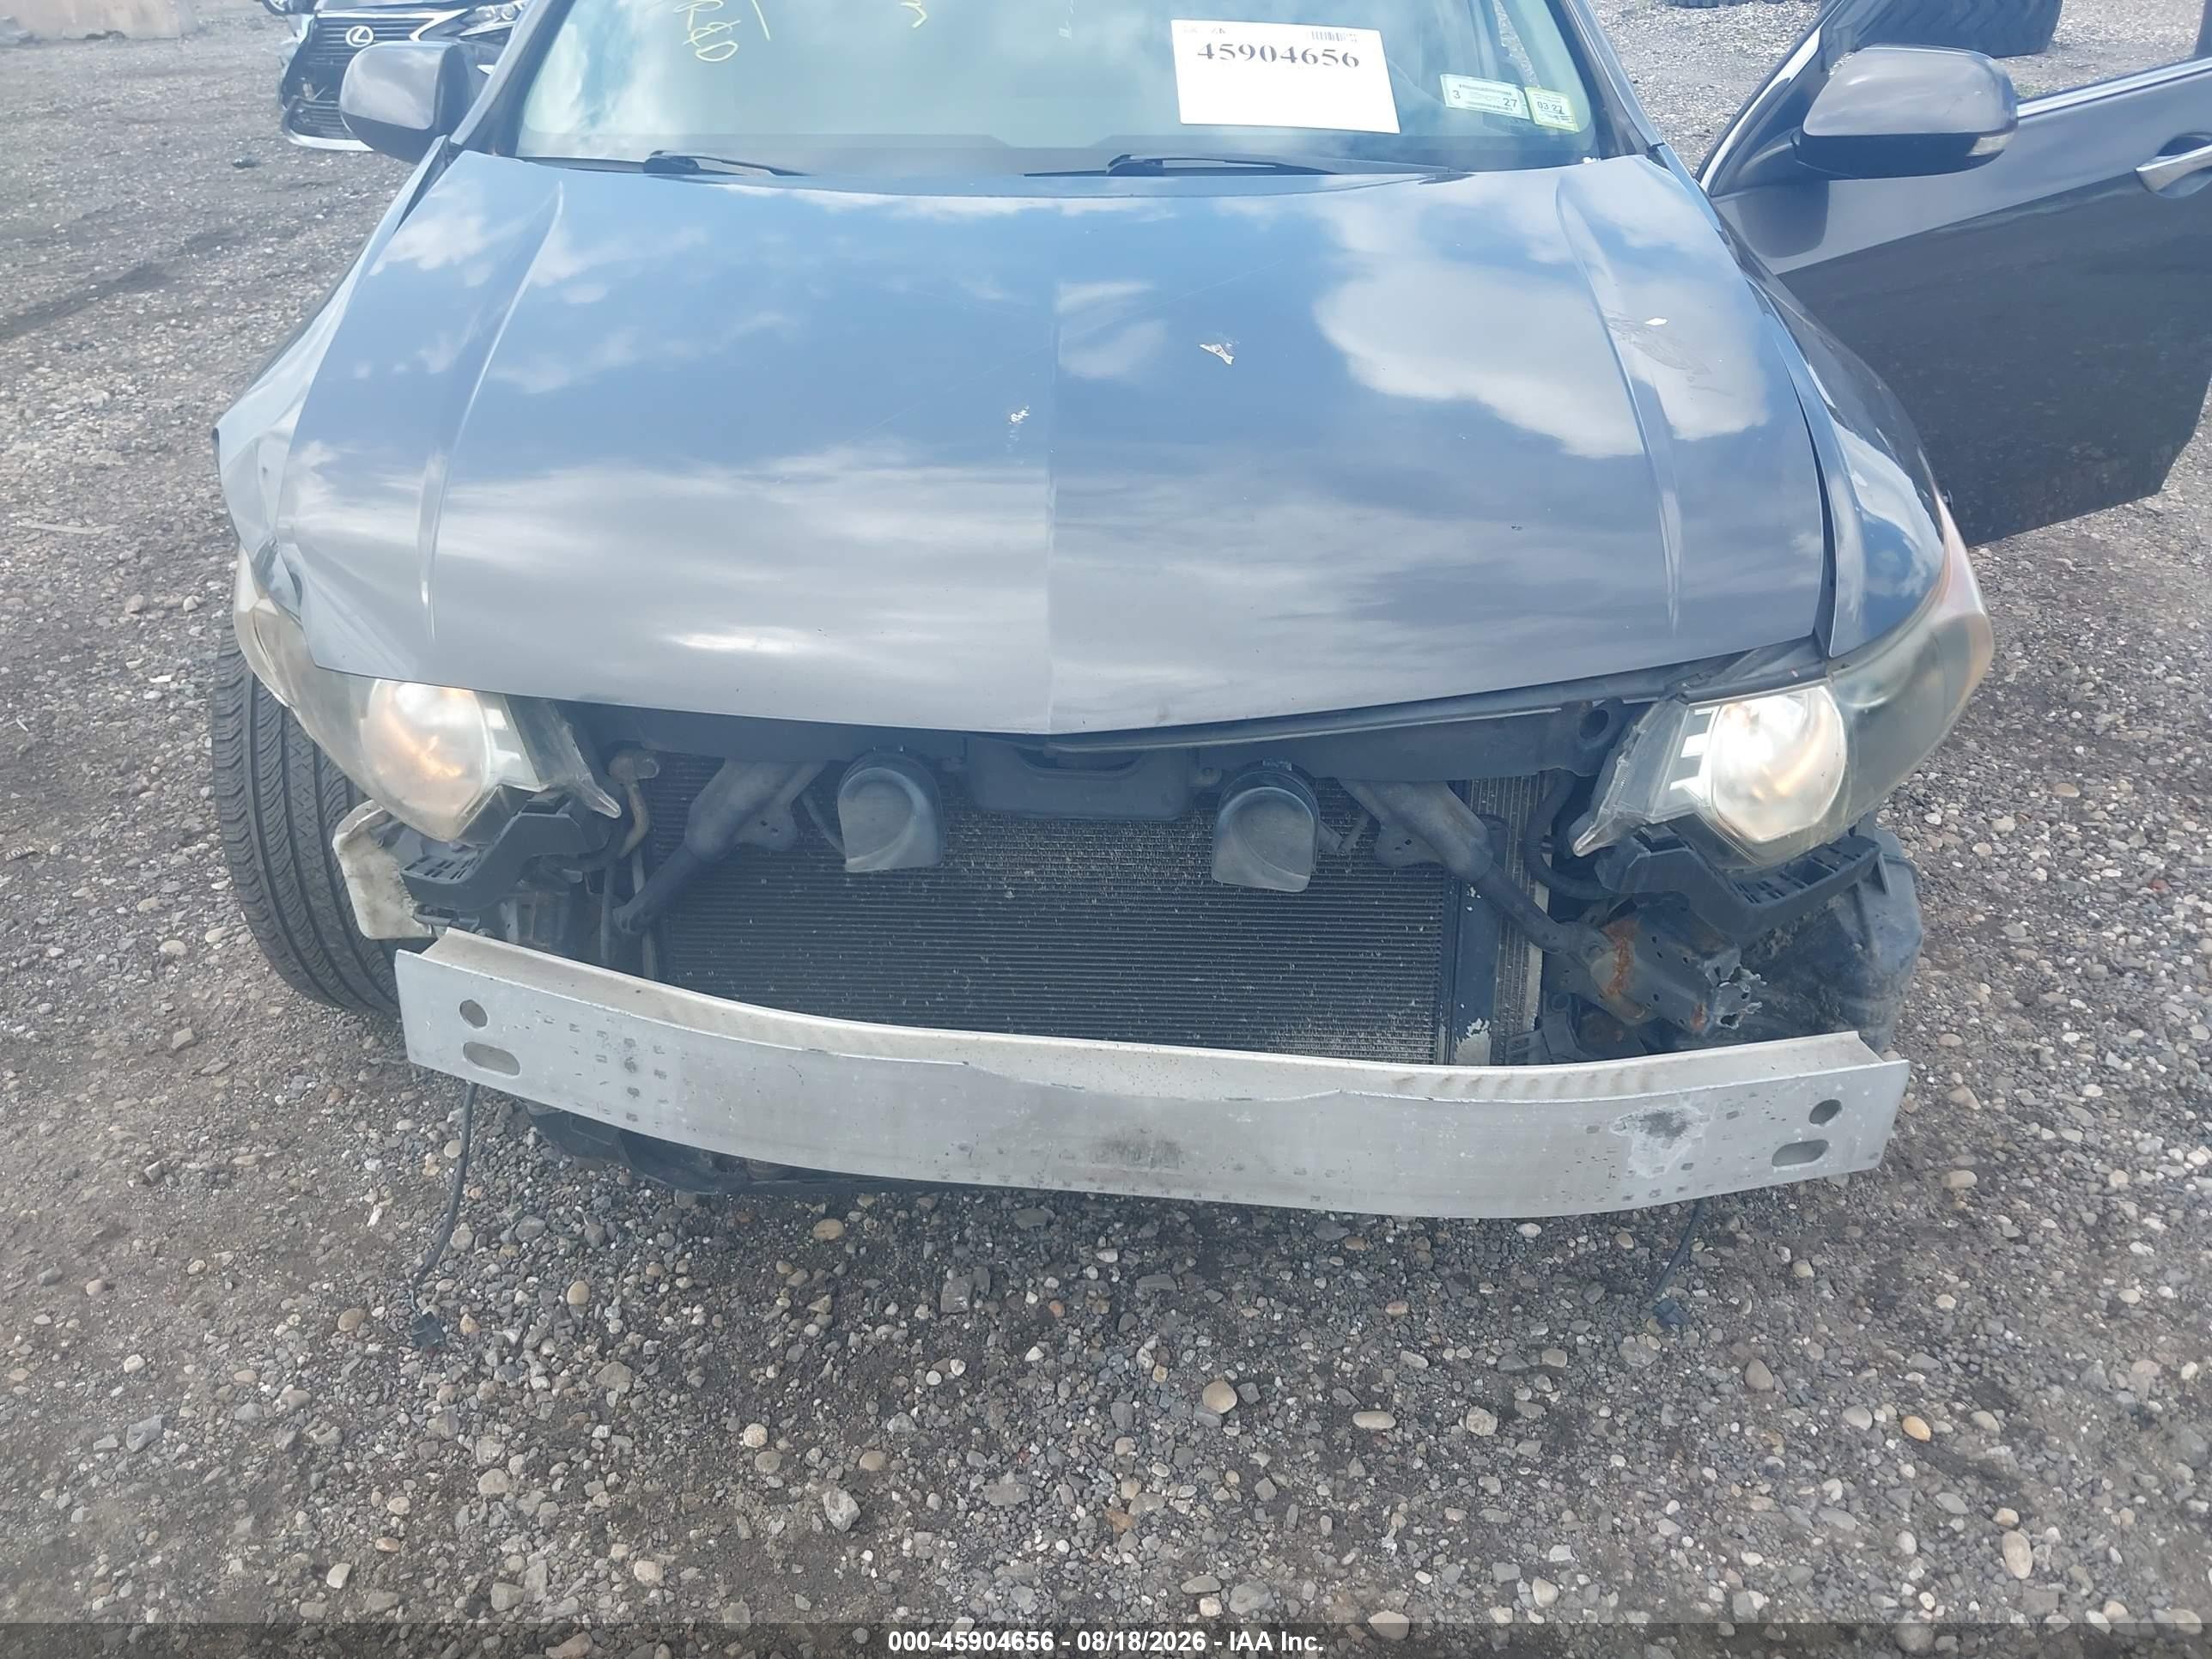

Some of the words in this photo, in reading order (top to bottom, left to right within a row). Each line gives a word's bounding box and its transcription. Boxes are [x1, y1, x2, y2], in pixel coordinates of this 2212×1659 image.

[1197, 42, 1360, 69] 45904656
[1452, 89, 1462, 100] 3
[1503, 97, 1518, 108] 27
